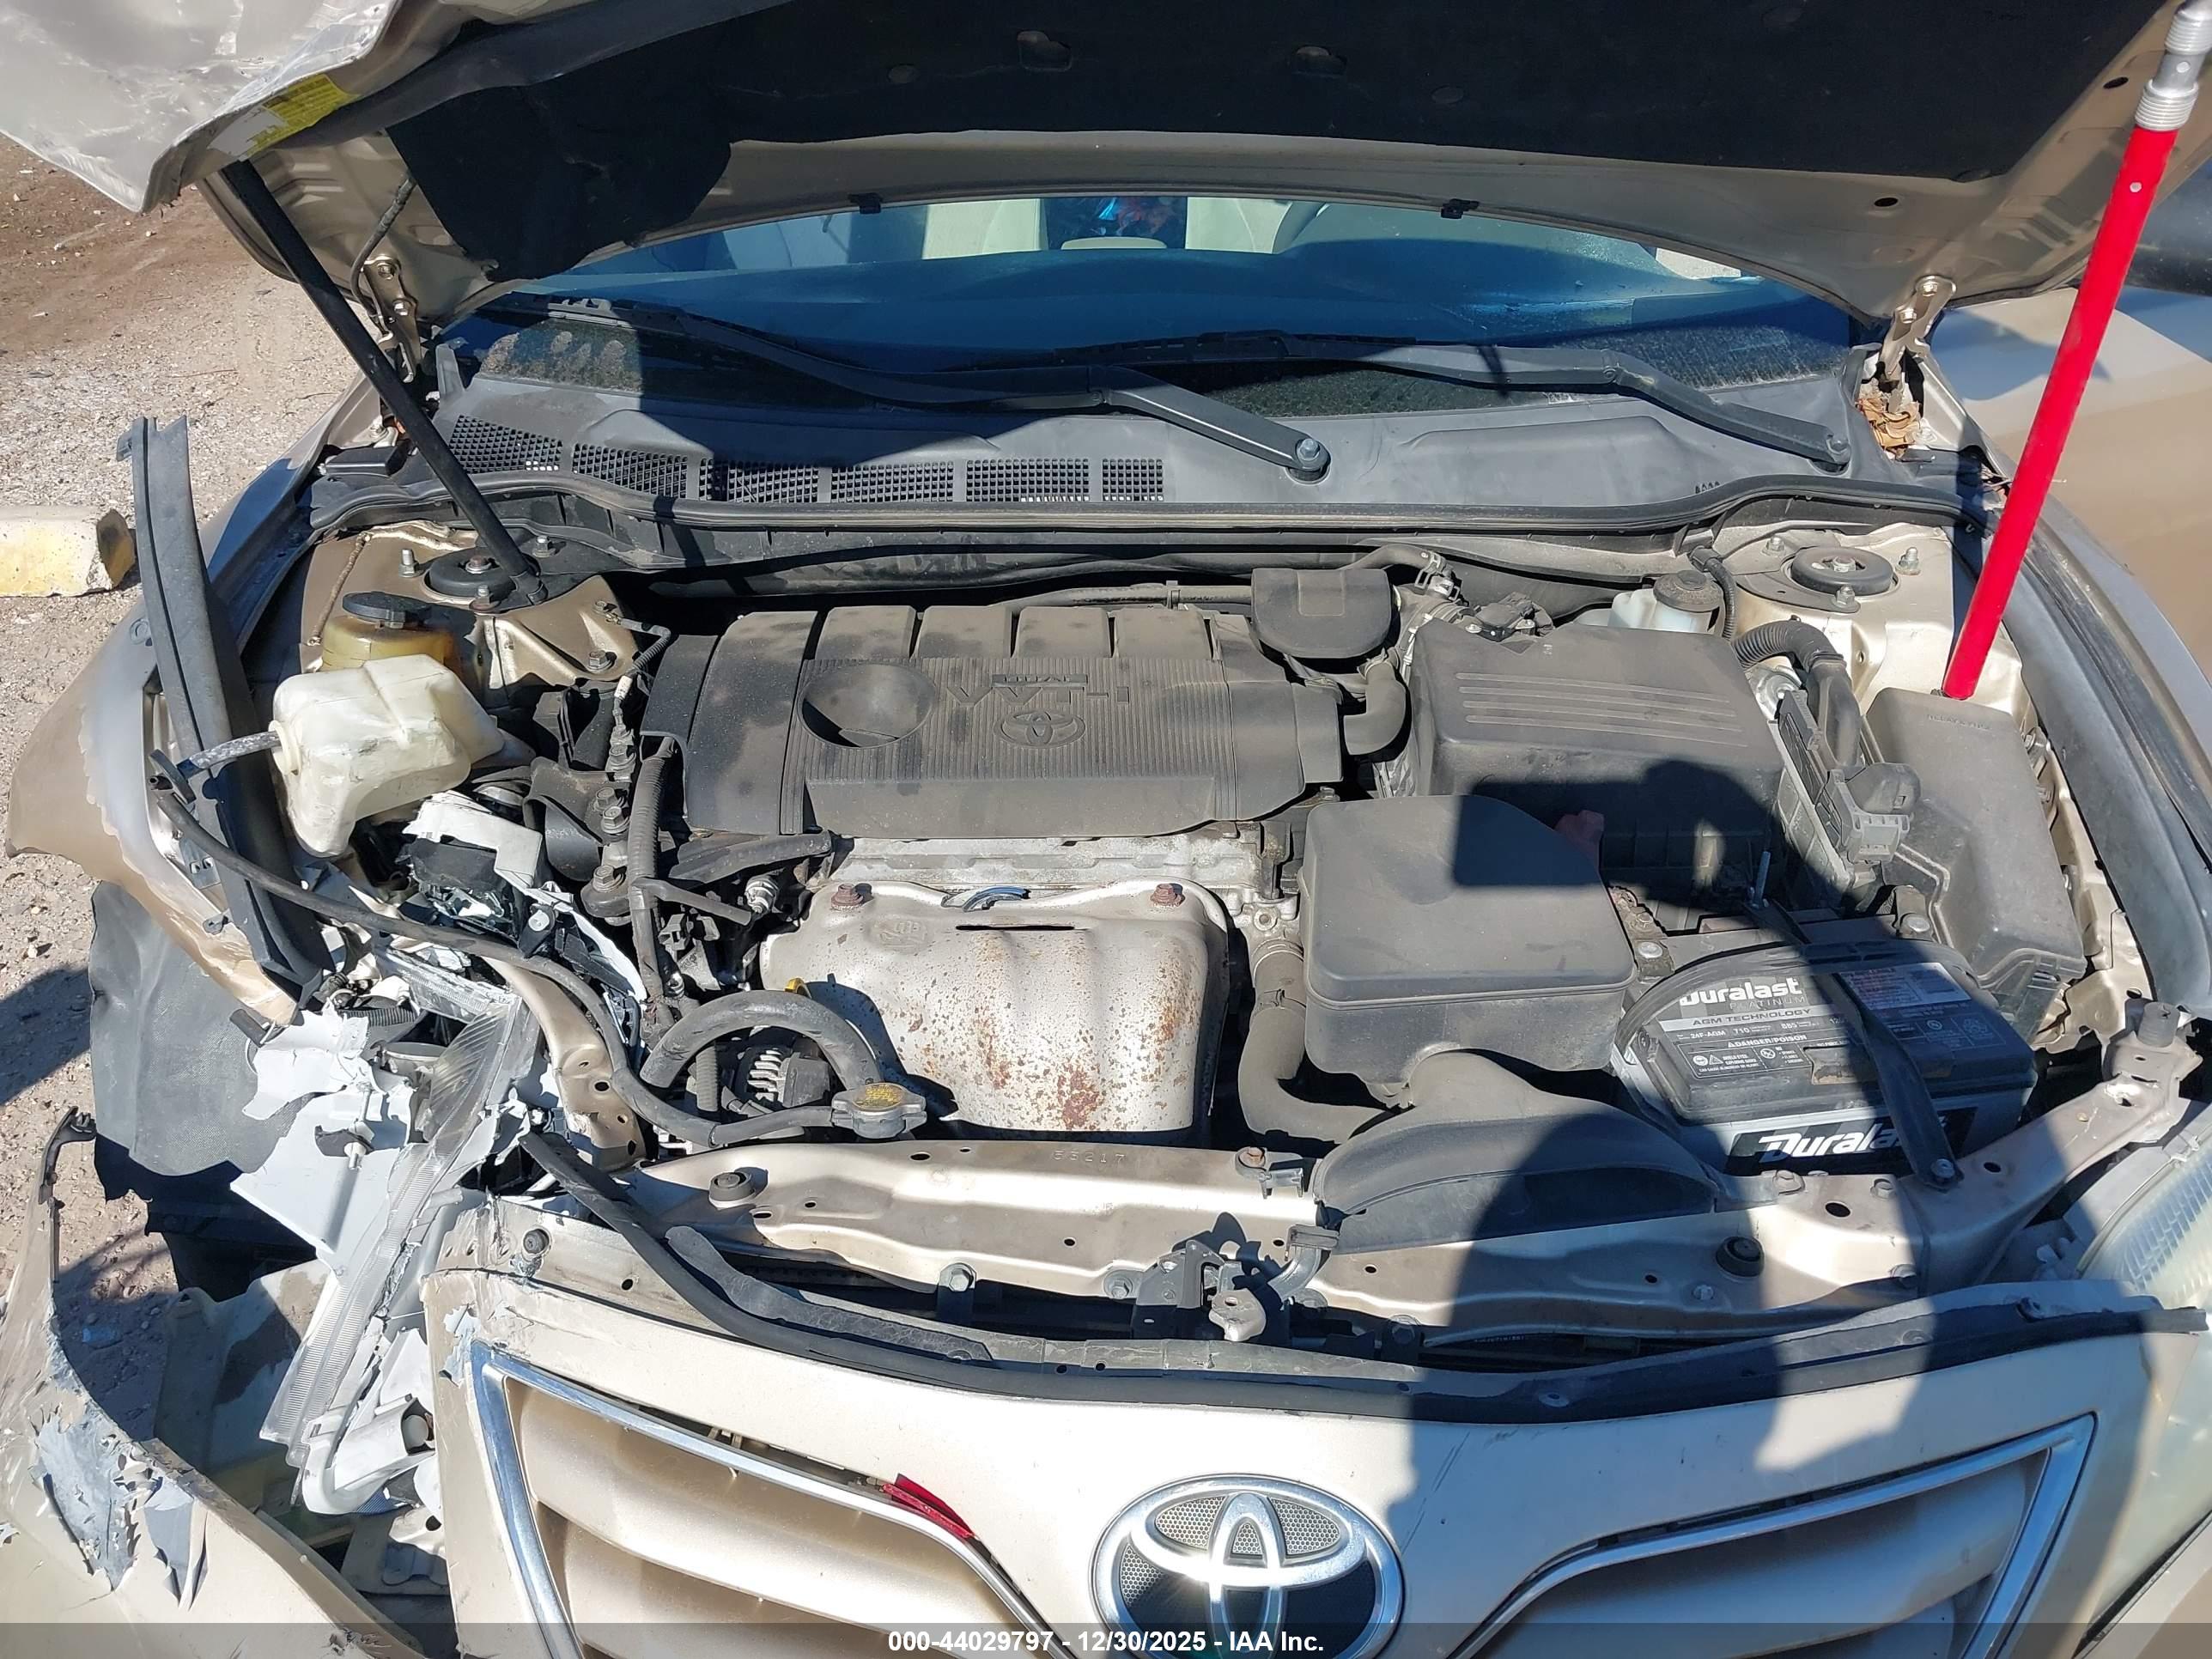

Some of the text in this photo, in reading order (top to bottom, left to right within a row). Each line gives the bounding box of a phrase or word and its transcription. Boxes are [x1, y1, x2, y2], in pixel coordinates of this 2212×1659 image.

[1680, 977, 1802, 1006] Duralast
[1729, 996, 1806, 1011] PLATINUM
[1692, 1008, 1811, 1026] AGM TECHNOLOGY
